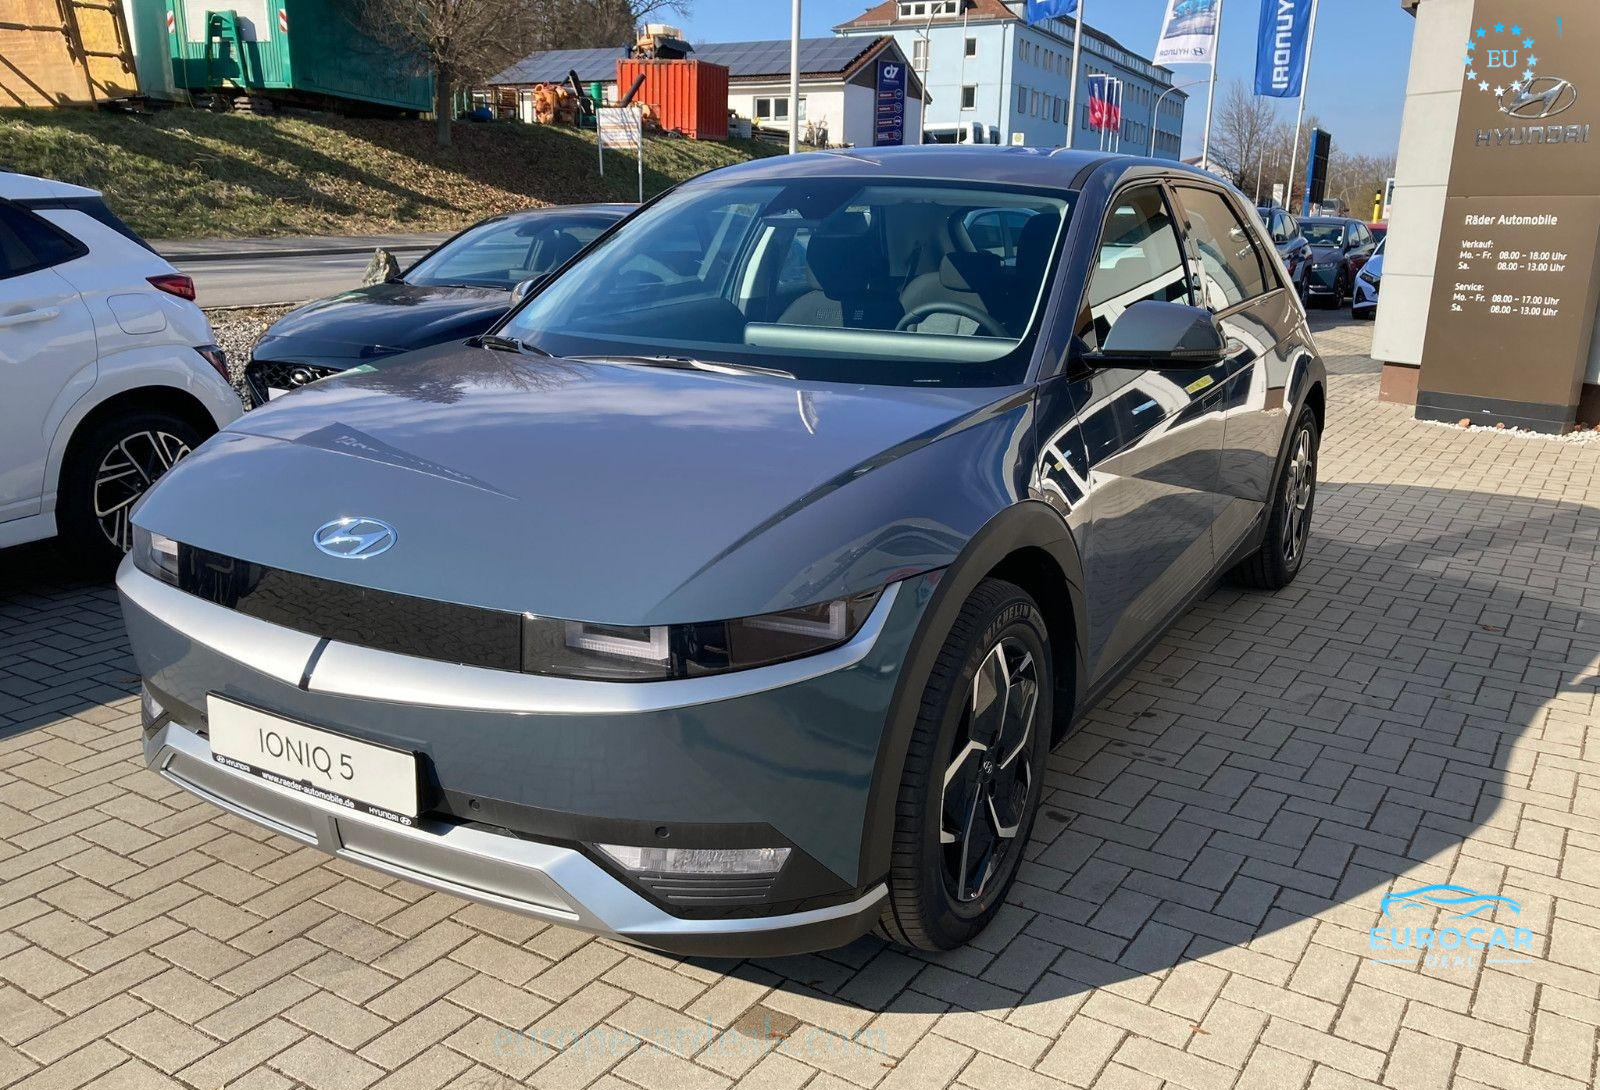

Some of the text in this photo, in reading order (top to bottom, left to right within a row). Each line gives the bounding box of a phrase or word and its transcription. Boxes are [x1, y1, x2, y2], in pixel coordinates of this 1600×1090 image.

[1475, 124, 1590, 147] HYUNDAI
[1465, 214, 1558, 226] Räder Automobile
[1461, 240, 1494, 249] Verkauf:
[1459, 250, 1474, 259] Mo.
[1482, 251, 1493, 259] Fr.
[1499, 251, 1520, 260] 08.00
[1529, 251, 1550, 260] 18.00
[1551, 251, 1568, 261] Uhr
[1457, 261, 1470, 270] Sa.
[1497, 262, 1518, 271] 08.00
[1527, 262, 1548, 271] 13.00
[1549, 263, 1565, 272] Uhr
[1454, 282, 1485, 291] Service:
[1453, 293, 1467, 301] Mo.
[1475, 294, 1486, 302] Fr.
[1491, 294, 1513, 303] 08.00
[1522, 295, 1542, 304] 17.00
[1543, 296, 1560, 305] Uhr
[1451, 303, 1463, 312] Sa.
[1520, 306, 1541, 315] 13.00
[1542, 307, 1559, 316] Uhr
[259, 728, 354, 780] IONIQ 5
[261, 771, 355, 809] www.raeder-automobile.de
[368, 806, 399, 822] HYUNDAI
